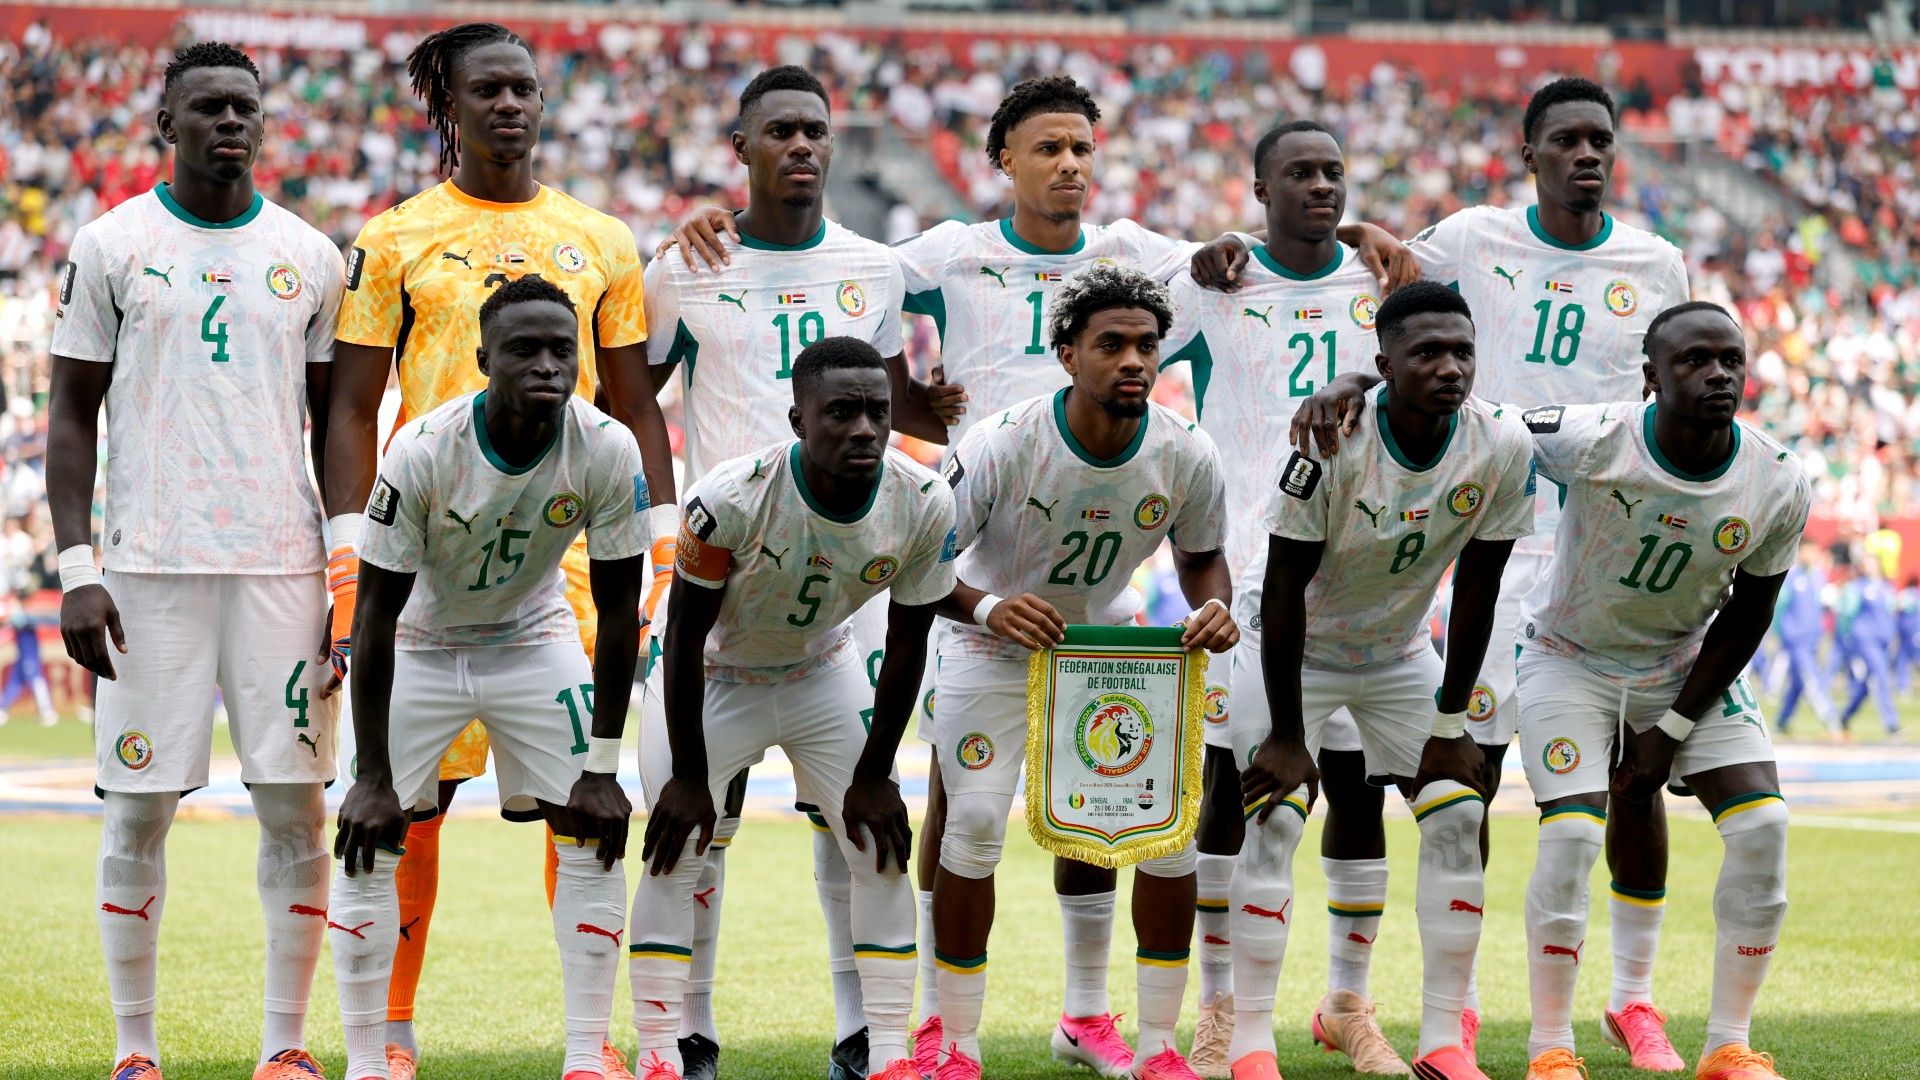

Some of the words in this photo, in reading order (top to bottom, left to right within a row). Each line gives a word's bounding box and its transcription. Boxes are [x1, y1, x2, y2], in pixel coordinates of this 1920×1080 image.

[201, 295, 229, 362] 4
[1024, 291, 1045, 354] 1
[1525, 299, 1585, 366] 18
[1288, 331, 1337, 397] 21
[467, 529, 532, 591] 15
[1048, 531, 1123, 586] 20
[1389, 530, 1426, 575] 8
[1618, 534, 1693, 594] 10
[787, 574, 832, 628] 5
[285, 660, 309, 728] 4
[1059, 659, 1114, 674] FÉDÉRATION
[1116, 660, 1177, 675] SÉNÉGALAISE
[1087, 676, 1099, 689] DE
[1101, 677, 1147, 690] FOOTBALL
